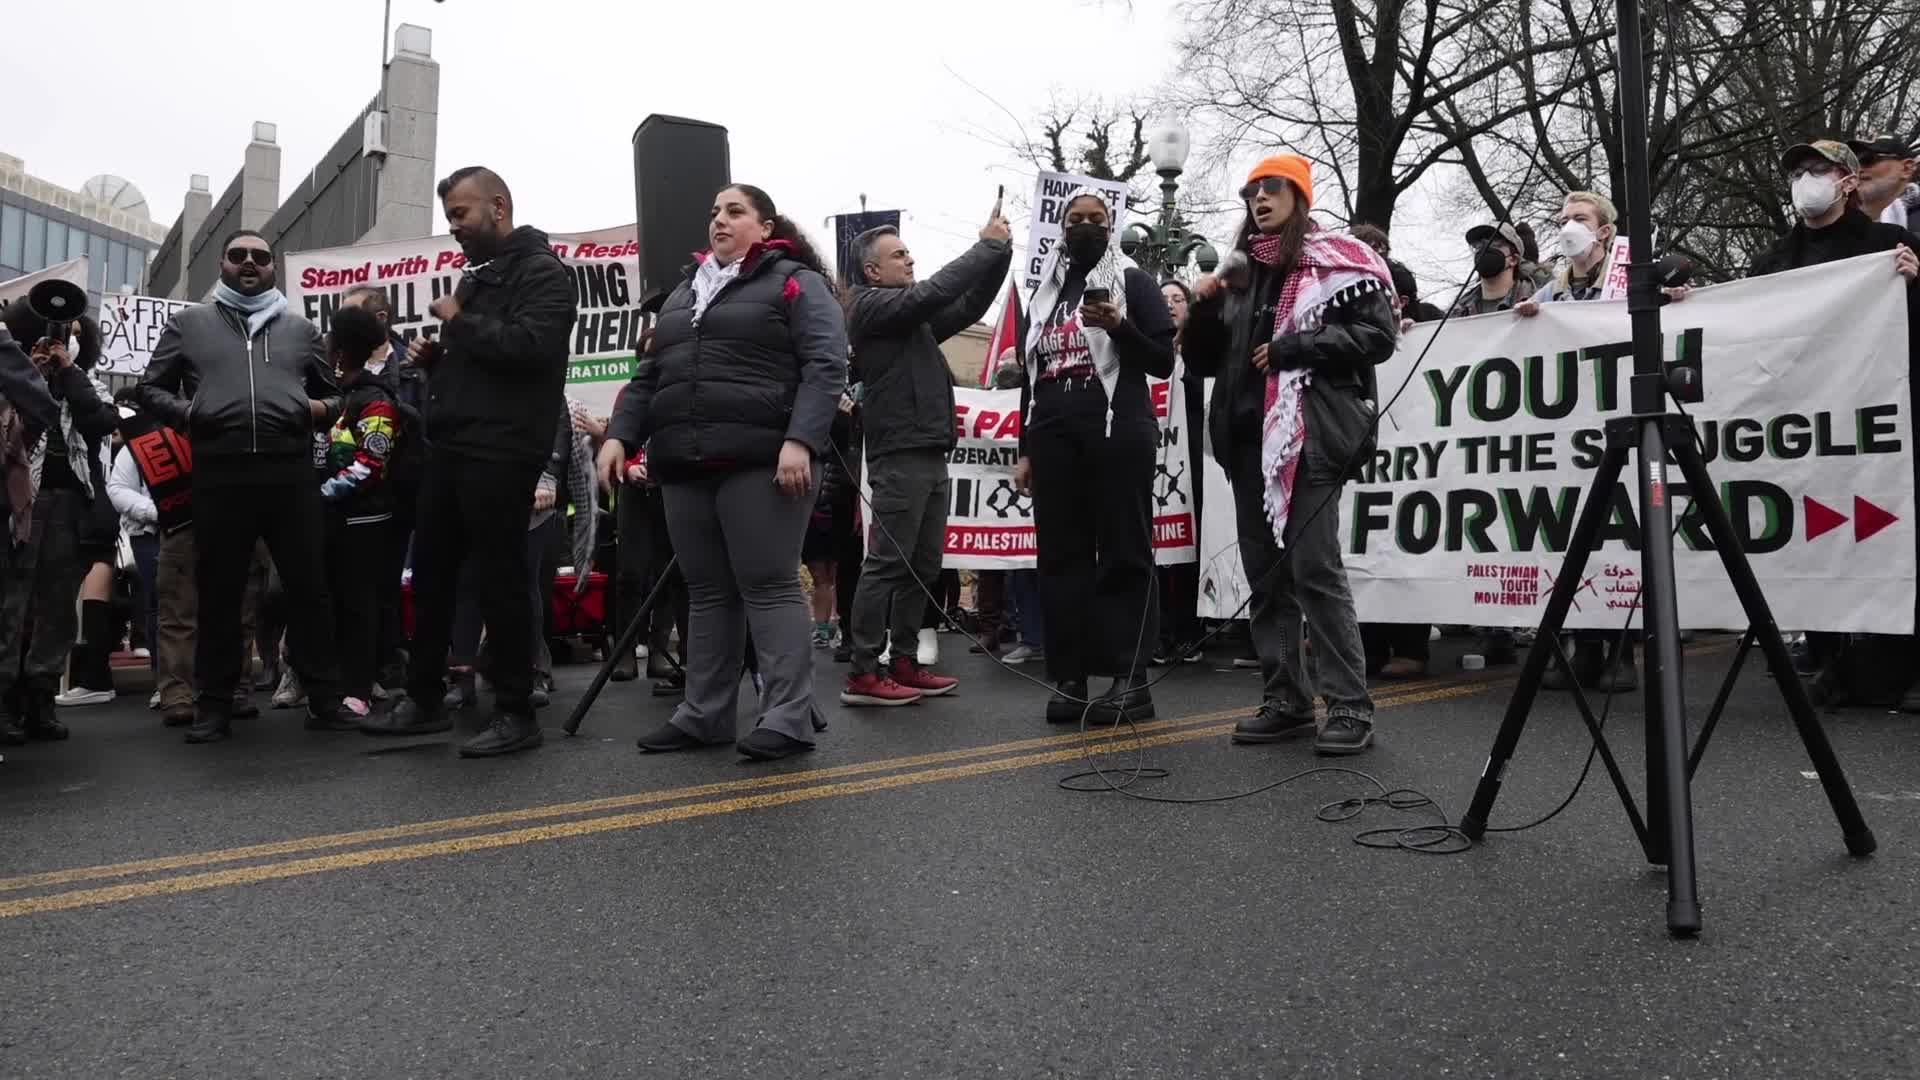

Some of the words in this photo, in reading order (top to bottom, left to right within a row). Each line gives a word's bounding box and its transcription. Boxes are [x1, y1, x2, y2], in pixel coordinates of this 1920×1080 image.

[300, 262, 372, 289] Stand
[377, 254, 429, 279] with
[574, 240, 640, 259] Resis
[1456, 432, 1557, 475] THE
[947, 532, 959, 549] 2
[1467, 564, 1539, 579] PALESTINIAN
[1500, 579, 1538, 593] YOUTH
[1474, 592, 1538, 607] MOVEMENT
